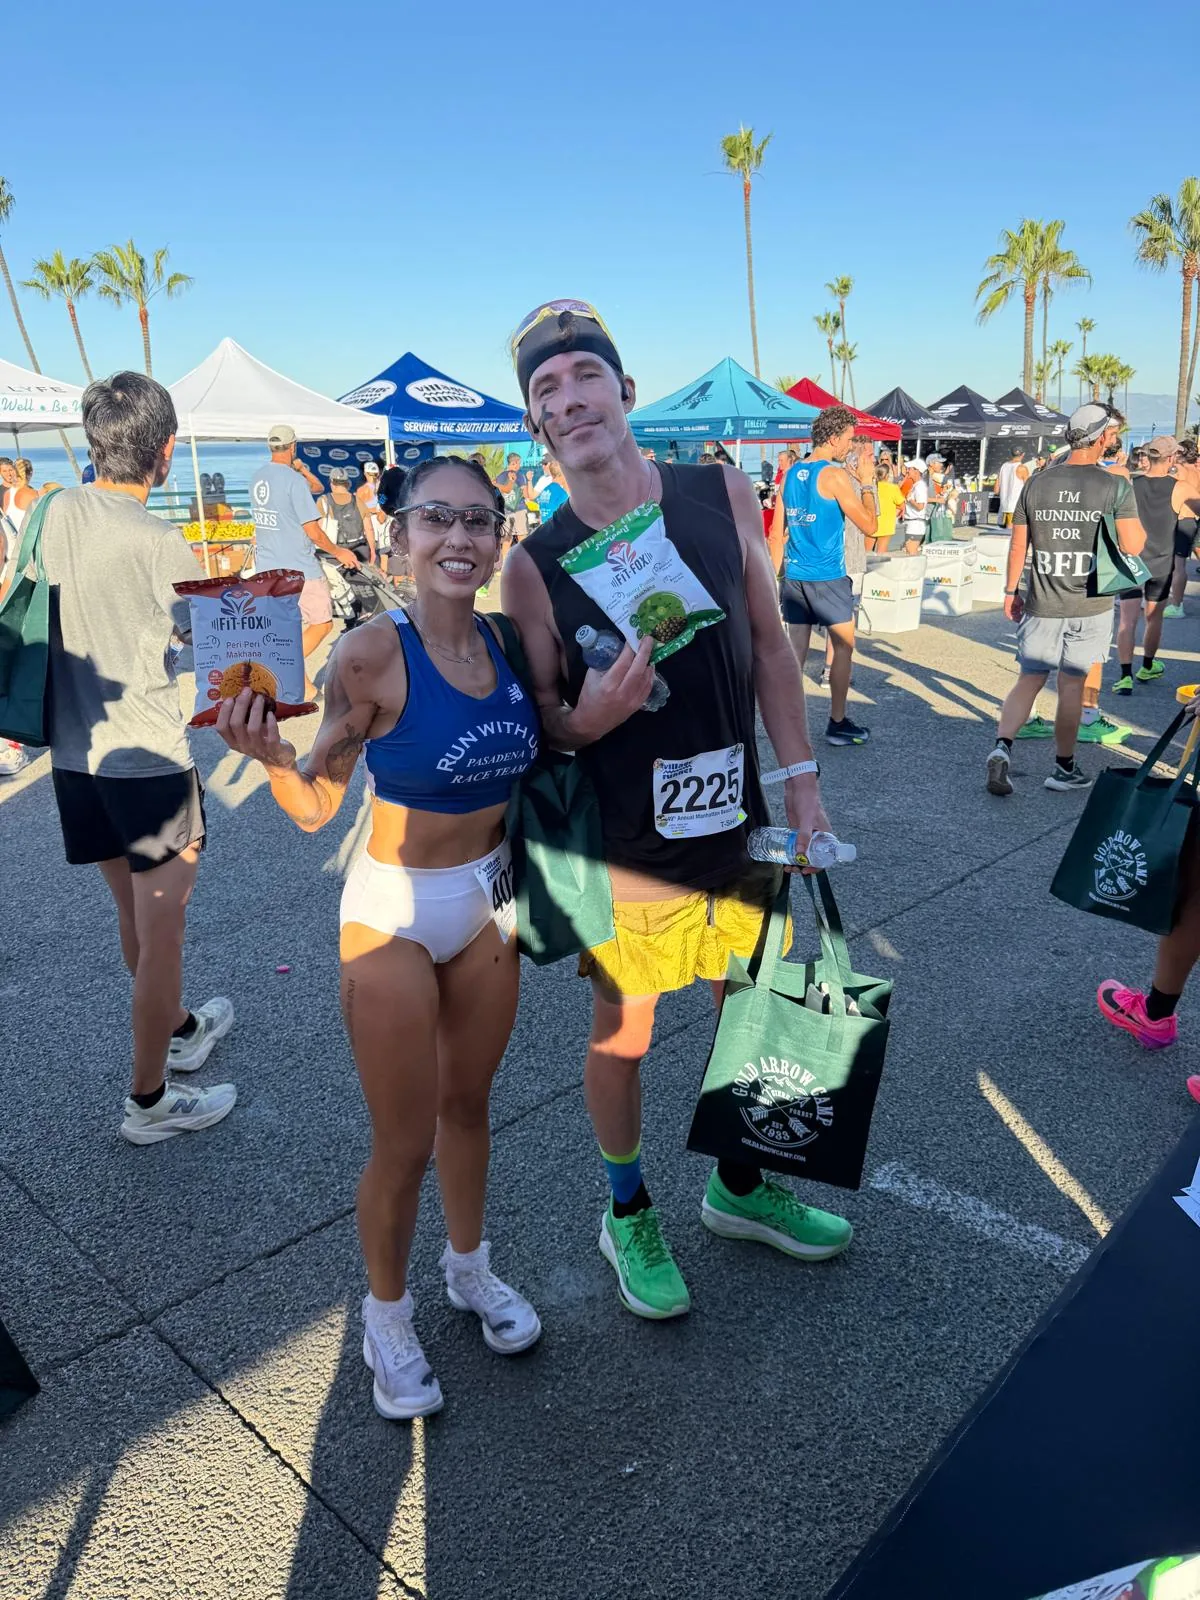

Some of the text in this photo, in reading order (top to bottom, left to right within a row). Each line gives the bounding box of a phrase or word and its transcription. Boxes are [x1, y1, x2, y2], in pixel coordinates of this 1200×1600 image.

[404, 421, 438, 432] SERVING
[440, 422, 457, 432] THE
[457, 422, 482, 433] SOUTH
[483, 423, 498, 433] BAY
[498, 423, 520, 433] SINCE
[1058, 490, 1081, 503] I'M
[1035, 510, 1102, 522] RUNNING
[1052, 528, 1080, 540] FOR
[1035, 550, 1097, 577] BFD
[226, 640, 260, 649] Peri Peri
[226, 650, 262, 658] Makhana
[436, 731, 479, 773] RUN
[476, 721, 528, 739] WITH
[466, 750, 526, 768] PASADENA
[450, 763, 529, 784] RACE TEAM
[660, 767, 739, 815] 2225
[732, 1056, 834, 1127] GOLD ARROW CAMP
[789, 1108, 814, 1119] FOREST
[762, 1125, 791, 1141] 1933
